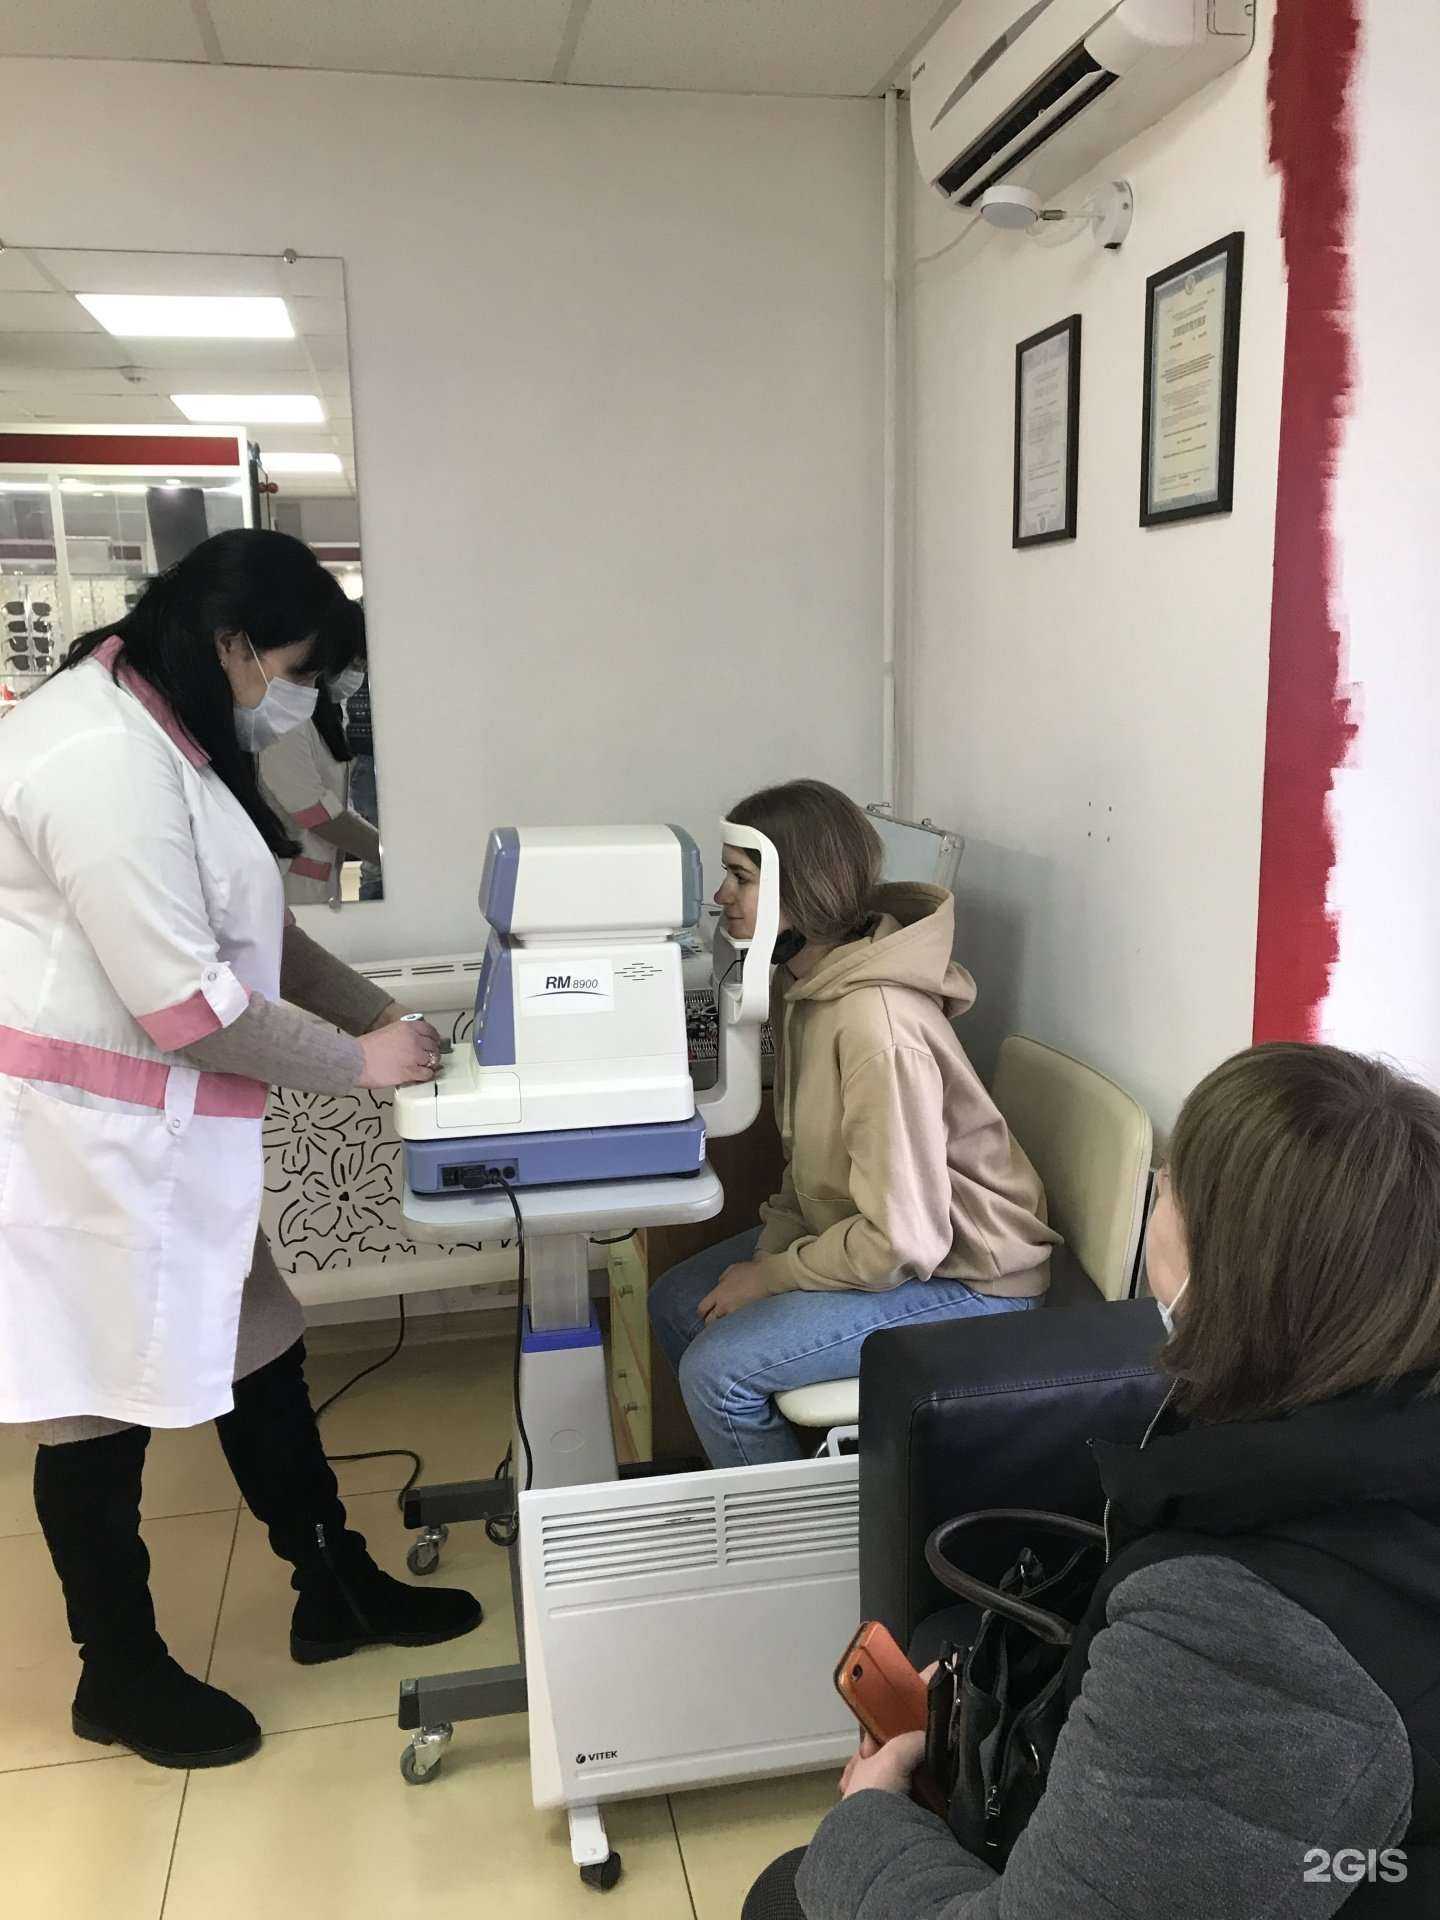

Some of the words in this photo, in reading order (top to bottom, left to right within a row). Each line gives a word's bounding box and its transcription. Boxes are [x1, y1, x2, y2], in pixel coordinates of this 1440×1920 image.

[545, 975, 571, 989] RM
[572, 979, 599, 989] 8900
[588, 1750, 618, 1761] VITEK
